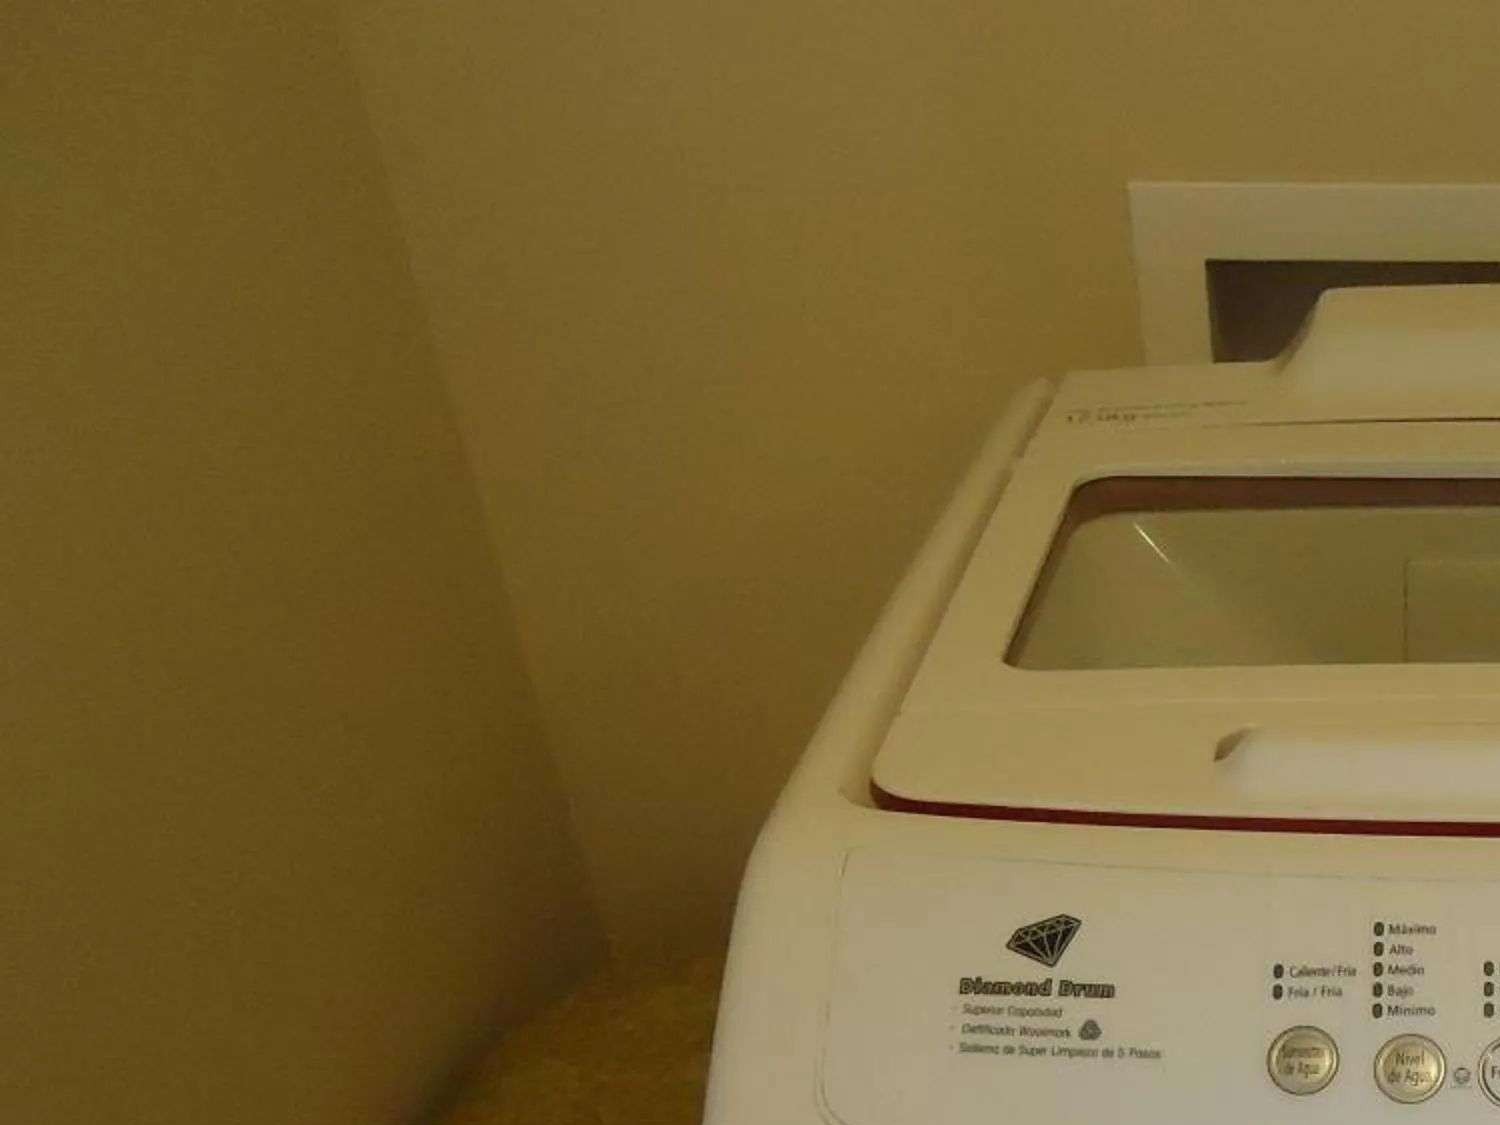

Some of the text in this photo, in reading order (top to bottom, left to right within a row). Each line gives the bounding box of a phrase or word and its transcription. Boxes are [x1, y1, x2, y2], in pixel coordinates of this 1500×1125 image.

[1389, 943, 1414, 955] Alto
[1387, 964, 1425, 976] Medio
[958, 976, 1115, 999] Diamond Drum
[1387, 985, 1414, 999] Bajo
[1396, 1050, 1425, 1066] Nivel
